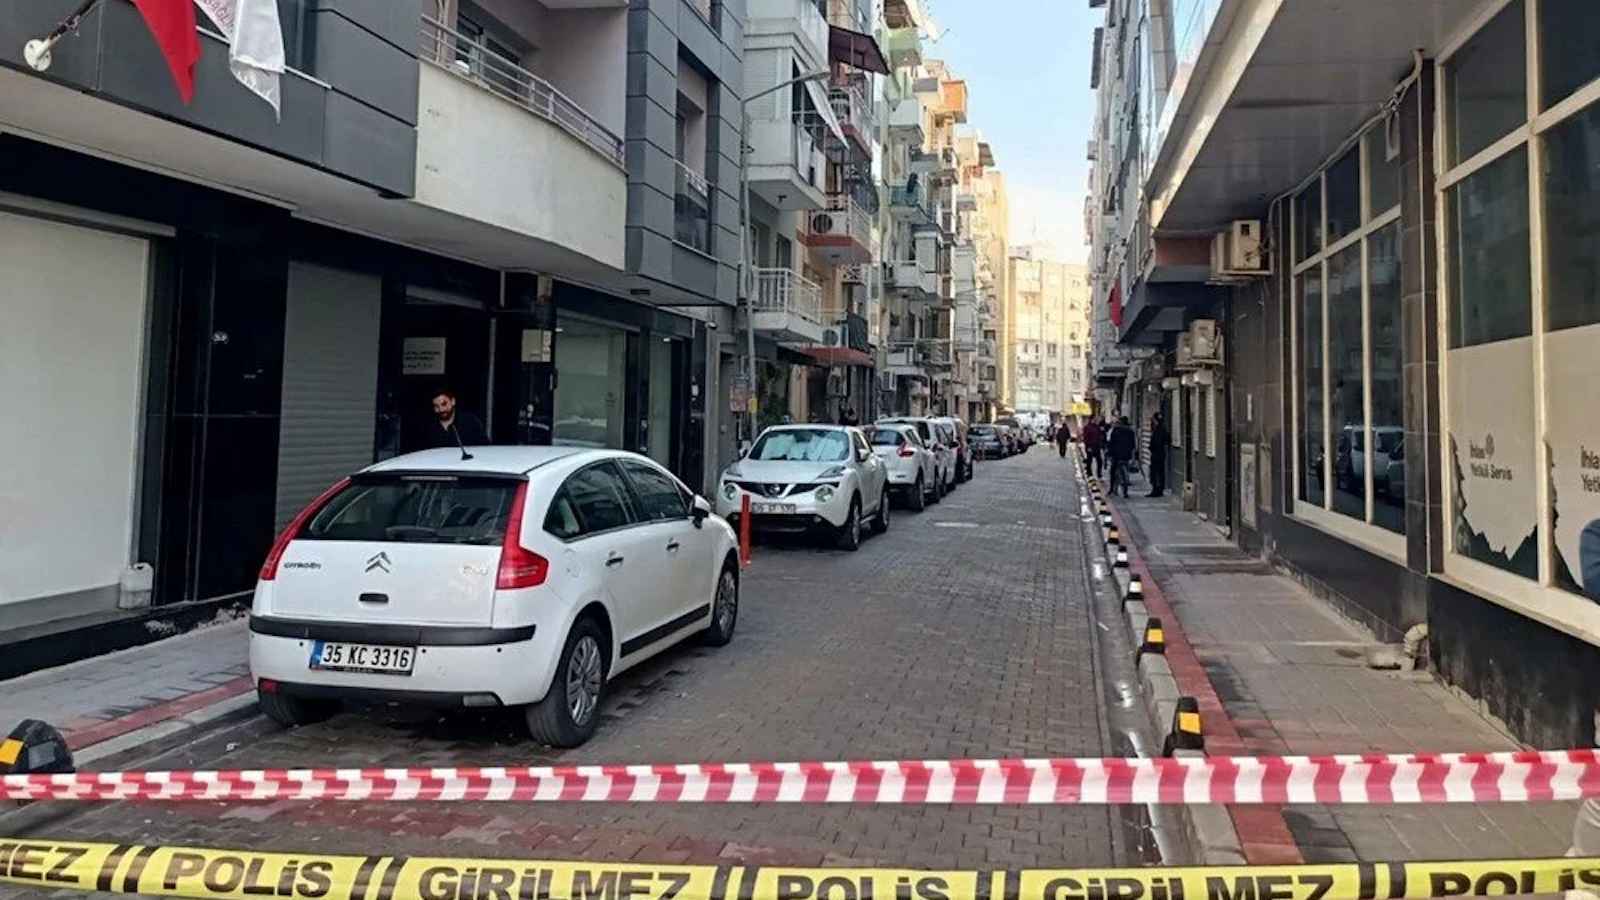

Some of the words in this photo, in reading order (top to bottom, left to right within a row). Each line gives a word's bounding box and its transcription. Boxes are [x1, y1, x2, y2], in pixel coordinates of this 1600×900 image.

[323, 644, 343, 664] 35
[347, 645, 368, 666] KC
[371, 647, 410, 669] 3316
